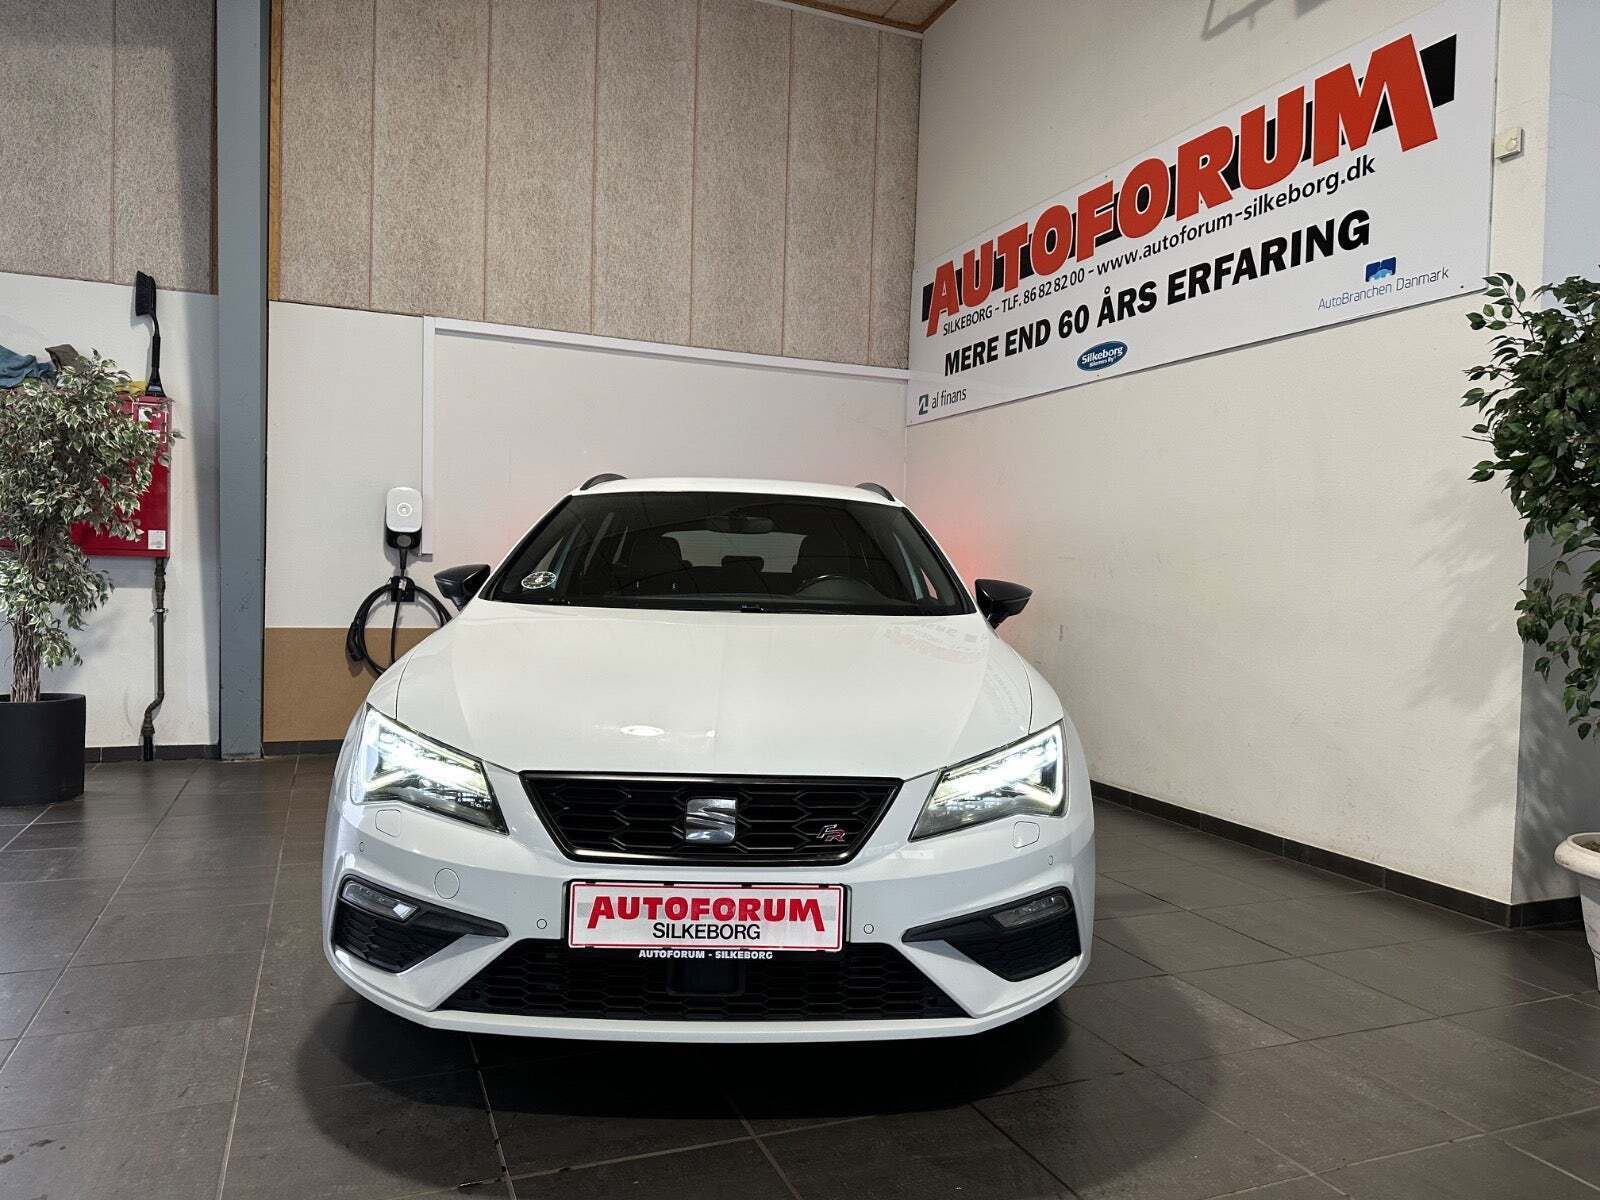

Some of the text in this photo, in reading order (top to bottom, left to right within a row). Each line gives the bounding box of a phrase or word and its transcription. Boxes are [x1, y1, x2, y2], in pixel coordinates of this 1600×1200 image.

[926, 33, 1437, 337] AUTOFORUM
[943, 305, 992, 336] SILKEBORG
[1002, 294, 1022, 313] TLF.
[1096, 154, 1376, 275] www.autoforum-silkeborg.dk
[944, 209, 1370, 376] MERE END 60 ÅRS ERFARING
[1318, 267, 1449, 310] AutoBranchen Danmark
[1081, 346, 1123, 364] Silkeborg
[931, 388, 967, 408] al finans
[587, 896, 825, 932] AUTOFORUM
[652, 923, 761, 940] SILKEBORG
[639, 949, 705, 959] AUTOFORUM
[715, 950, 773, 960] SILKEBORG
